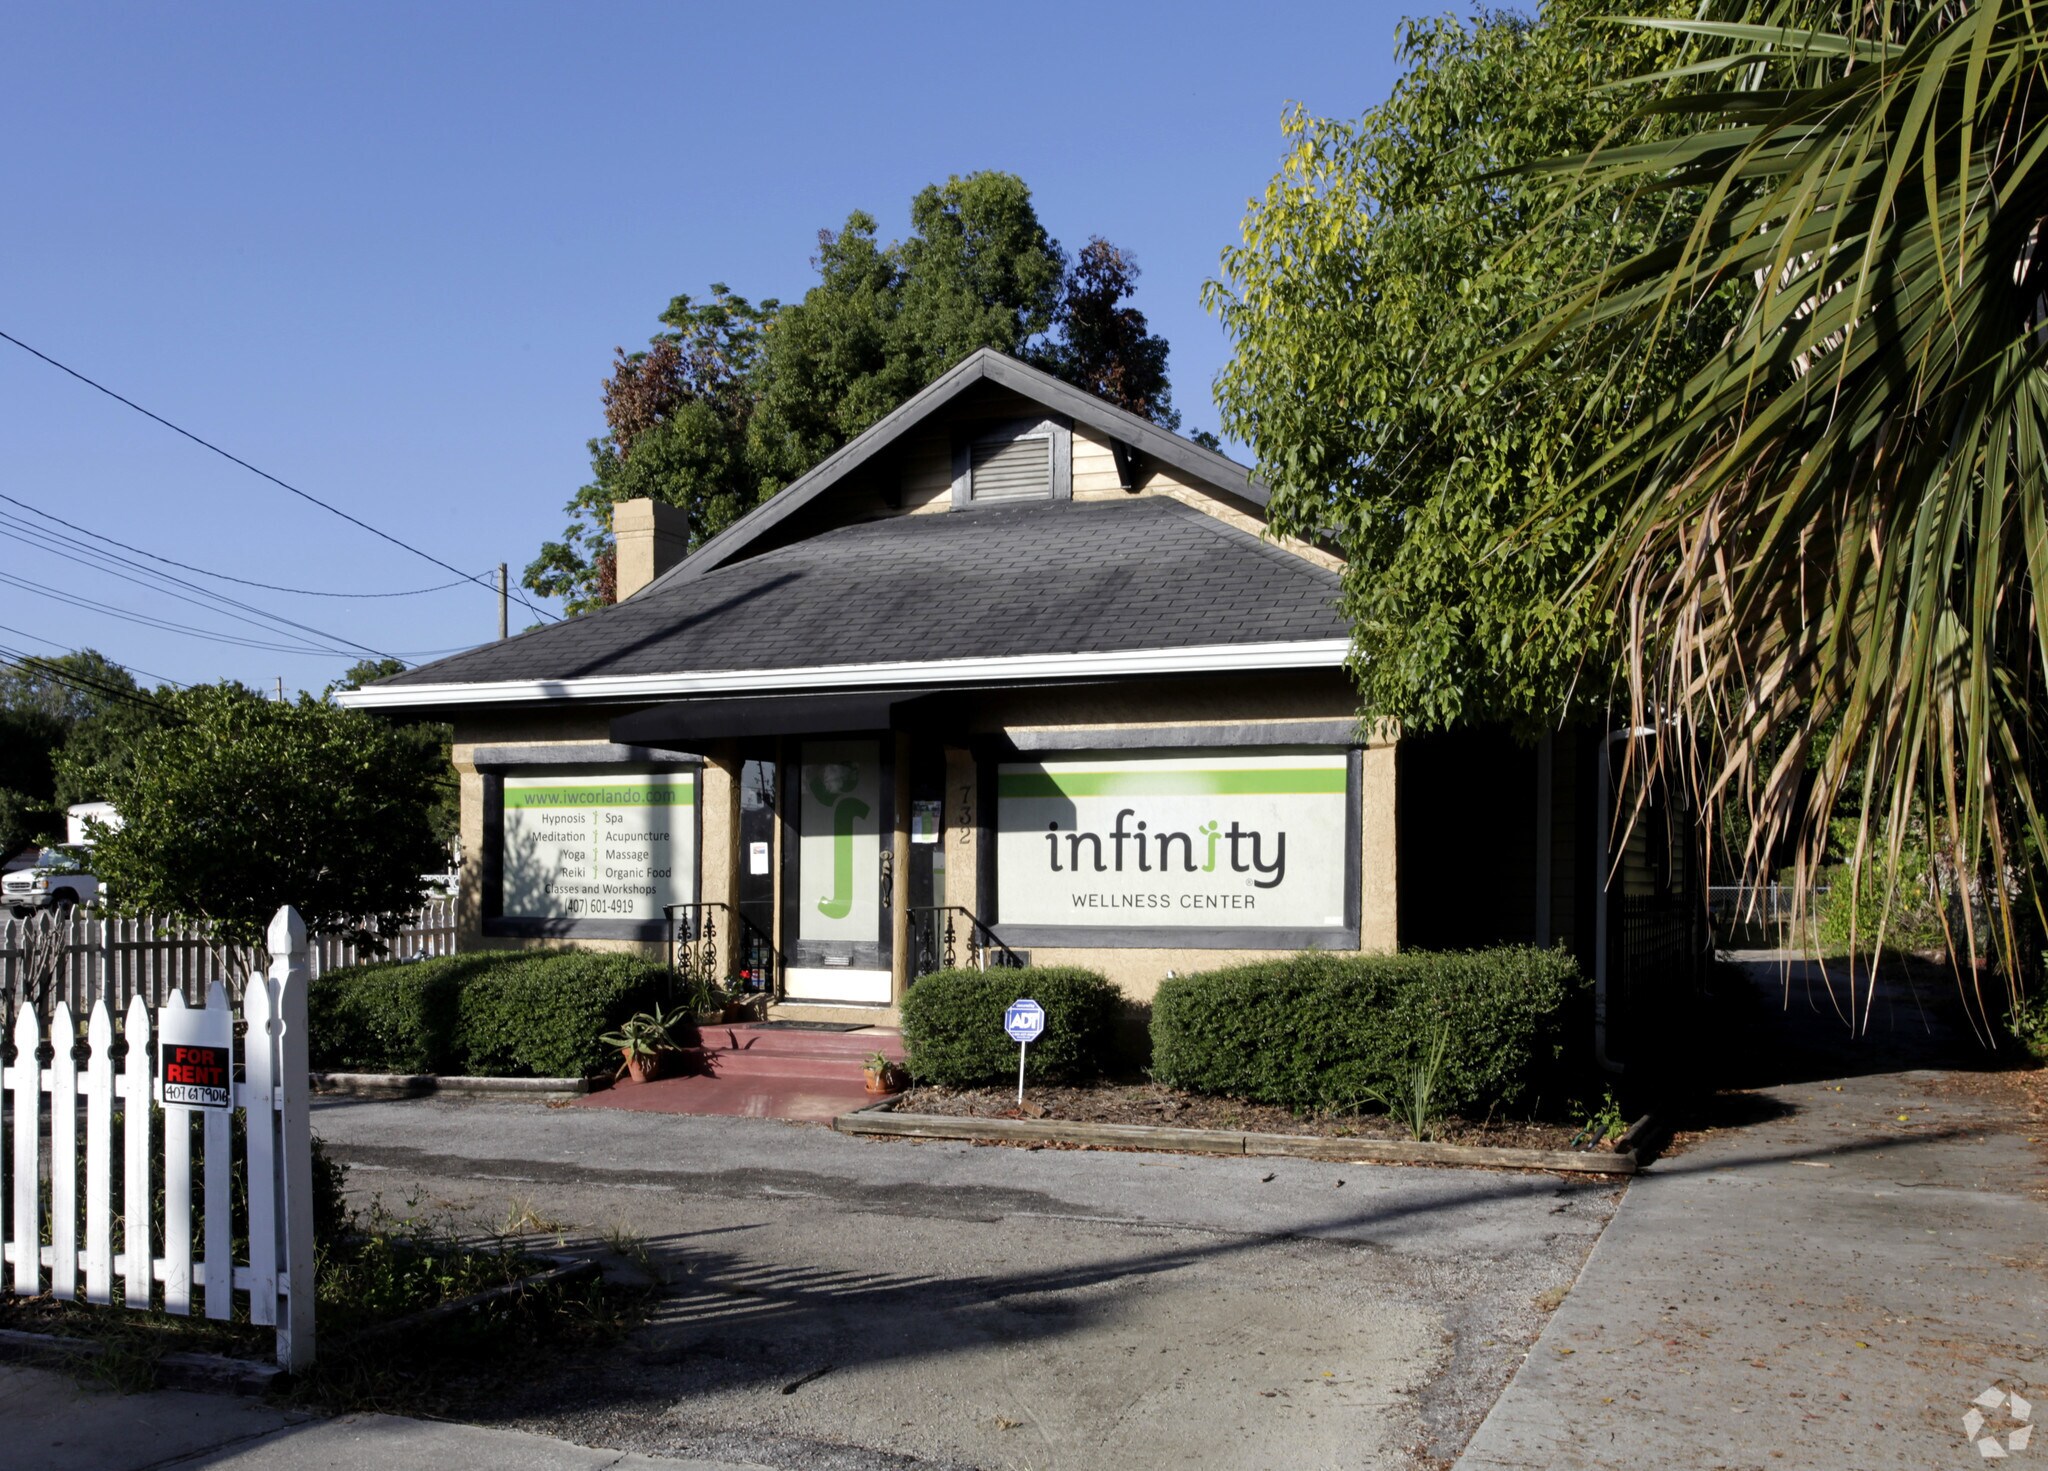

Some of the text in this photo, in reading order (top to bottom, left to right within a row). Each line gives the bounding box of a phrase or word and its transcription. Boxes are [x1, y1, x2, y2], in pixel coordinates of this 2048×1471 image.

[524, 788, 676, 805] www.iwcorlando.com
[541, 813, 586, 826] Hypnosis
[605, 813, 624, 826] Spa
[958, 786, 972, 845] 732
[532, 831, 586, 842] Meditation
[605, 831, 670, 844] Acupuncture
[562, 849, 586, 862] Yoga
[605, 849, 650, 862] Massage
[1045, 808, 1286, 889] infinity
[562, 866, 586, 878] Reiki
[605, 866, 672, 880] Organic Food
[545, 883, 657, 897] Classes and Workshops
[564, 899, 634, 916] (407) 601-4919
[1071, 893, 1255, 909] WELLNESS CENTER
[1010, 1012, 1039, 1029] ADT
[175, 1047, 215, 1065] FOR
[167, 1063, 223, 1085] RENT
[166, 1086, 185, 1100] 407
